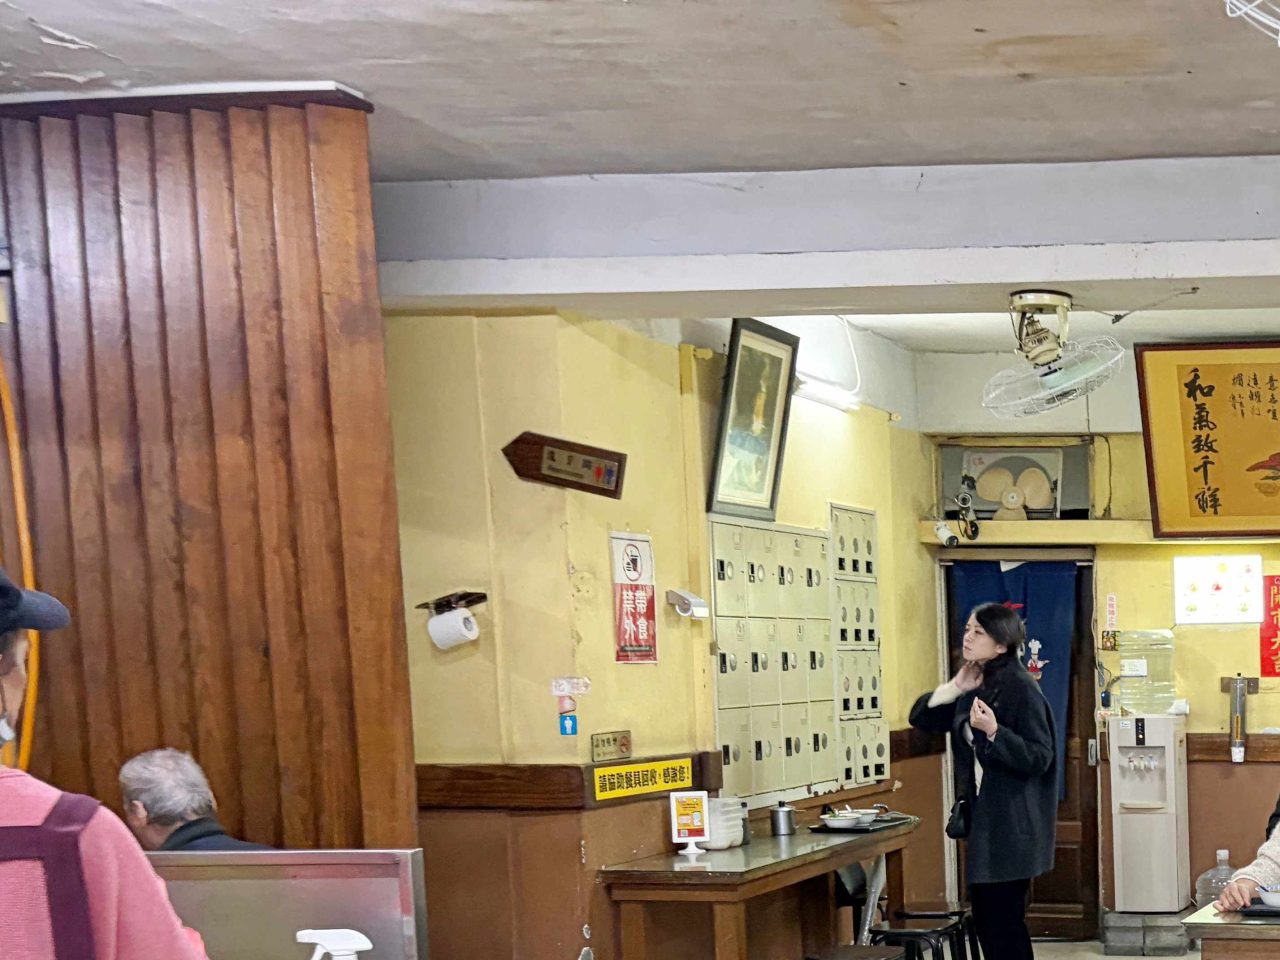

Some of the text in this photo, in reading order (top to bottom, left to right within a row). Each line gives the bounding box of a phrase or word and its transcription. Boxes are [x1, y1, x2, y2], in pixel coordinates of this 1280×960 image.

[1183, 367, 1222, 516] 和氣致千祥
